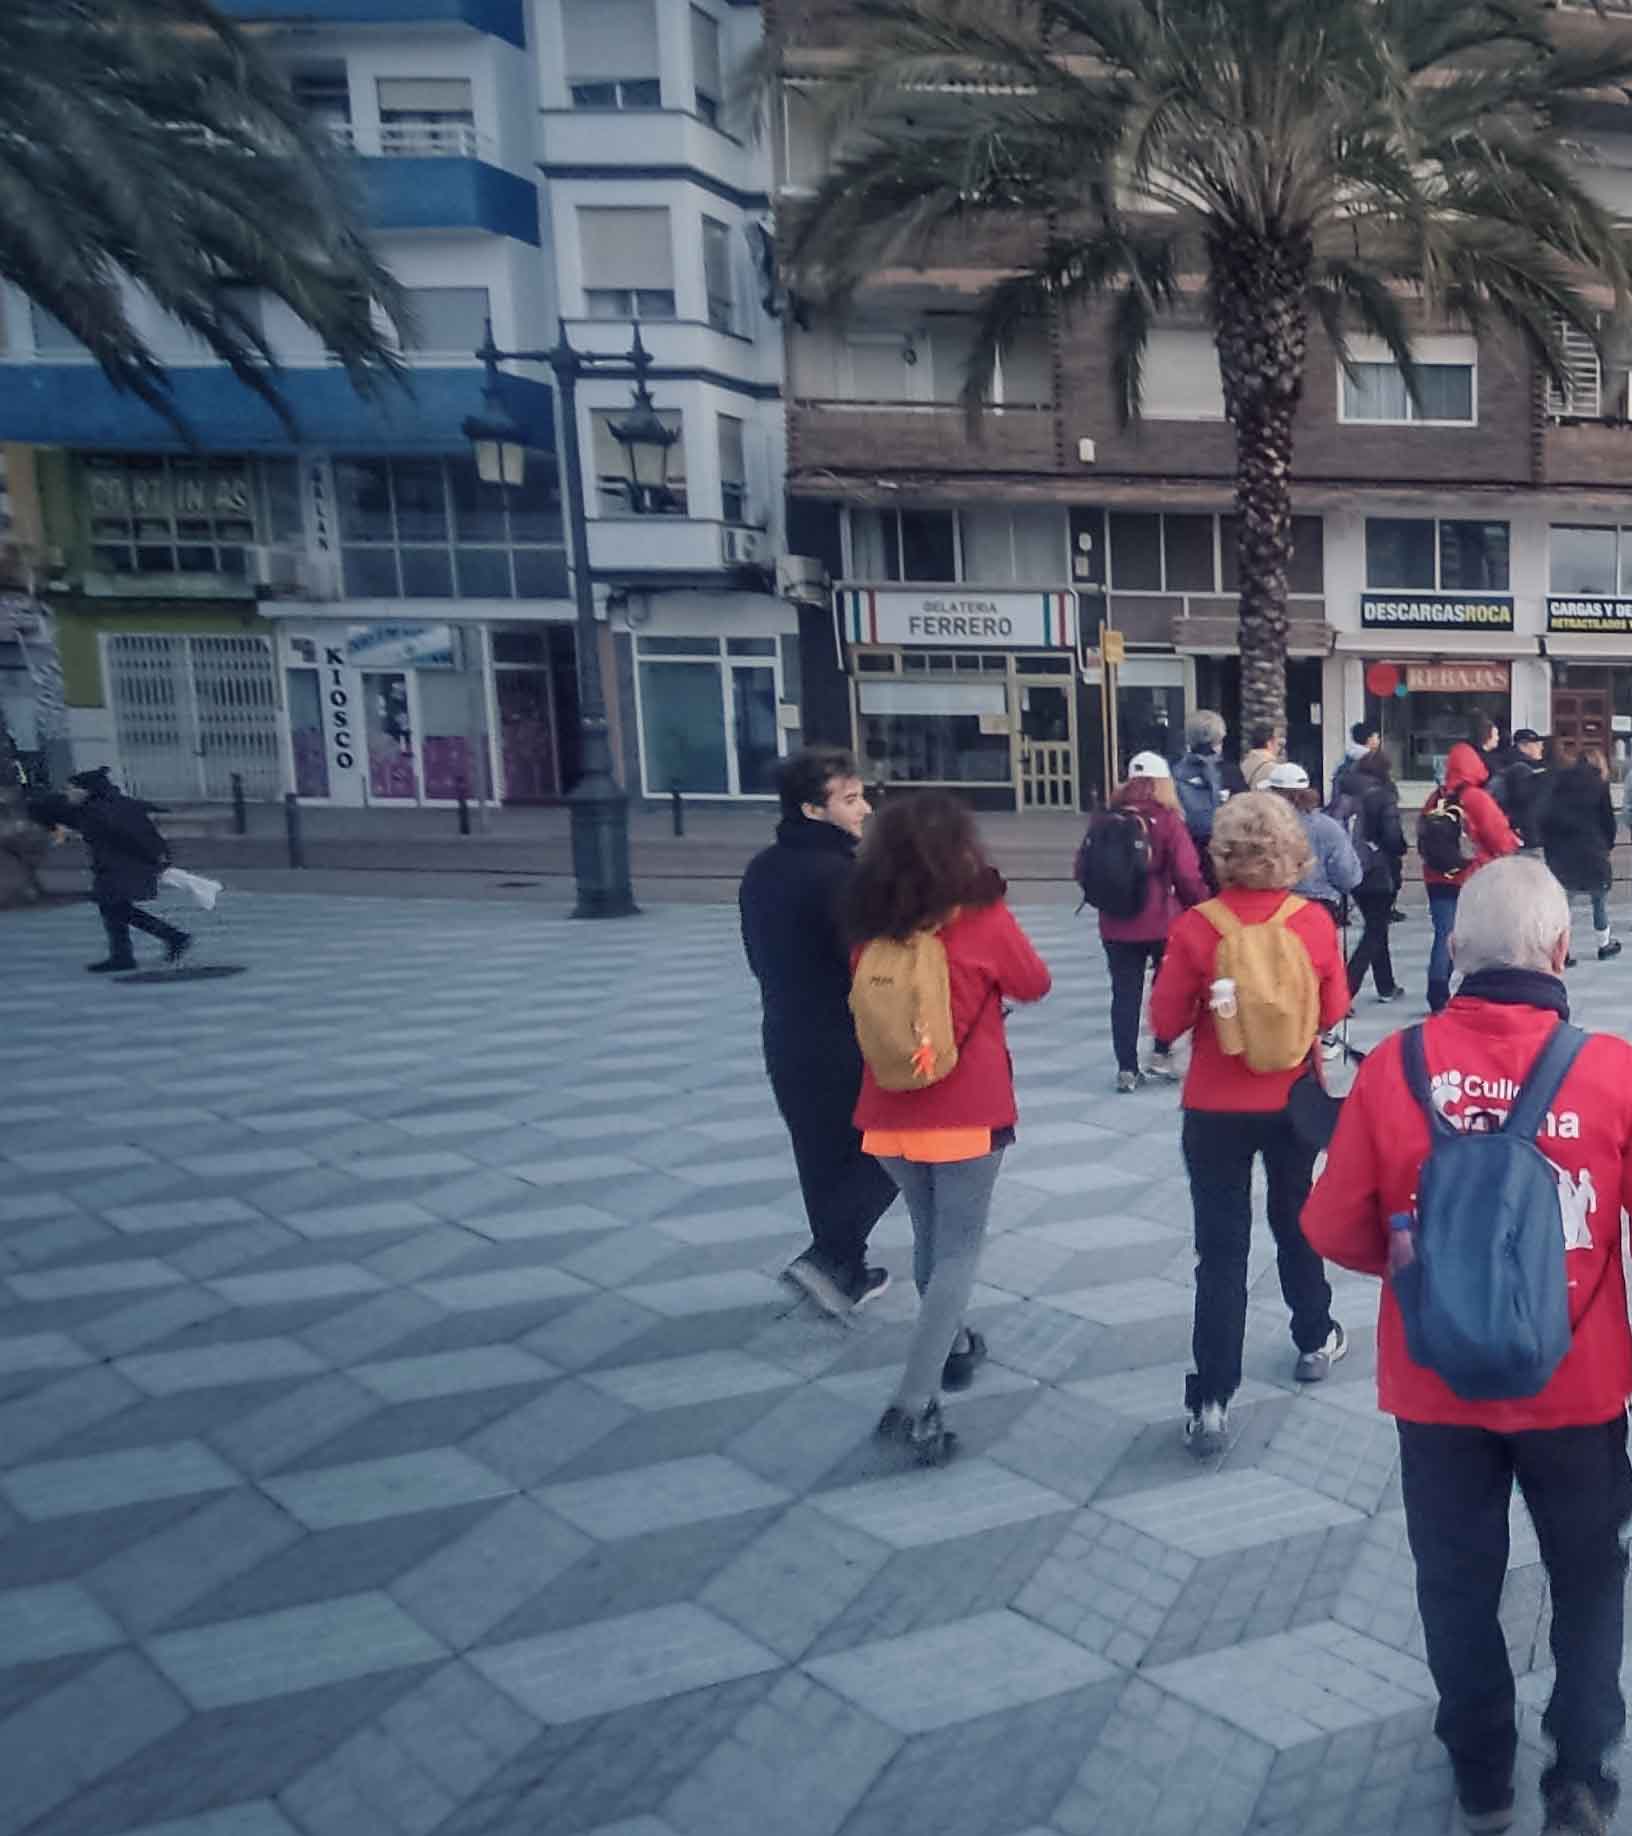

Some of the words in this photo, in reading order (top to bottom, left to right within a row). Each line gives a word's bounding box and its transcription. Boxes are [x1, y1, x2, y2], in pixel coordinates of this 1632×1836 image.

[1550, 602, 1602, 616] CARGAS
[1604, 603, 1613, 617] Y
[908, 615, 1013, 636] FERRERO
[1408, 668, 1508, 688] REBAJAS
[325, 648, 353, 768] KIOSCO
